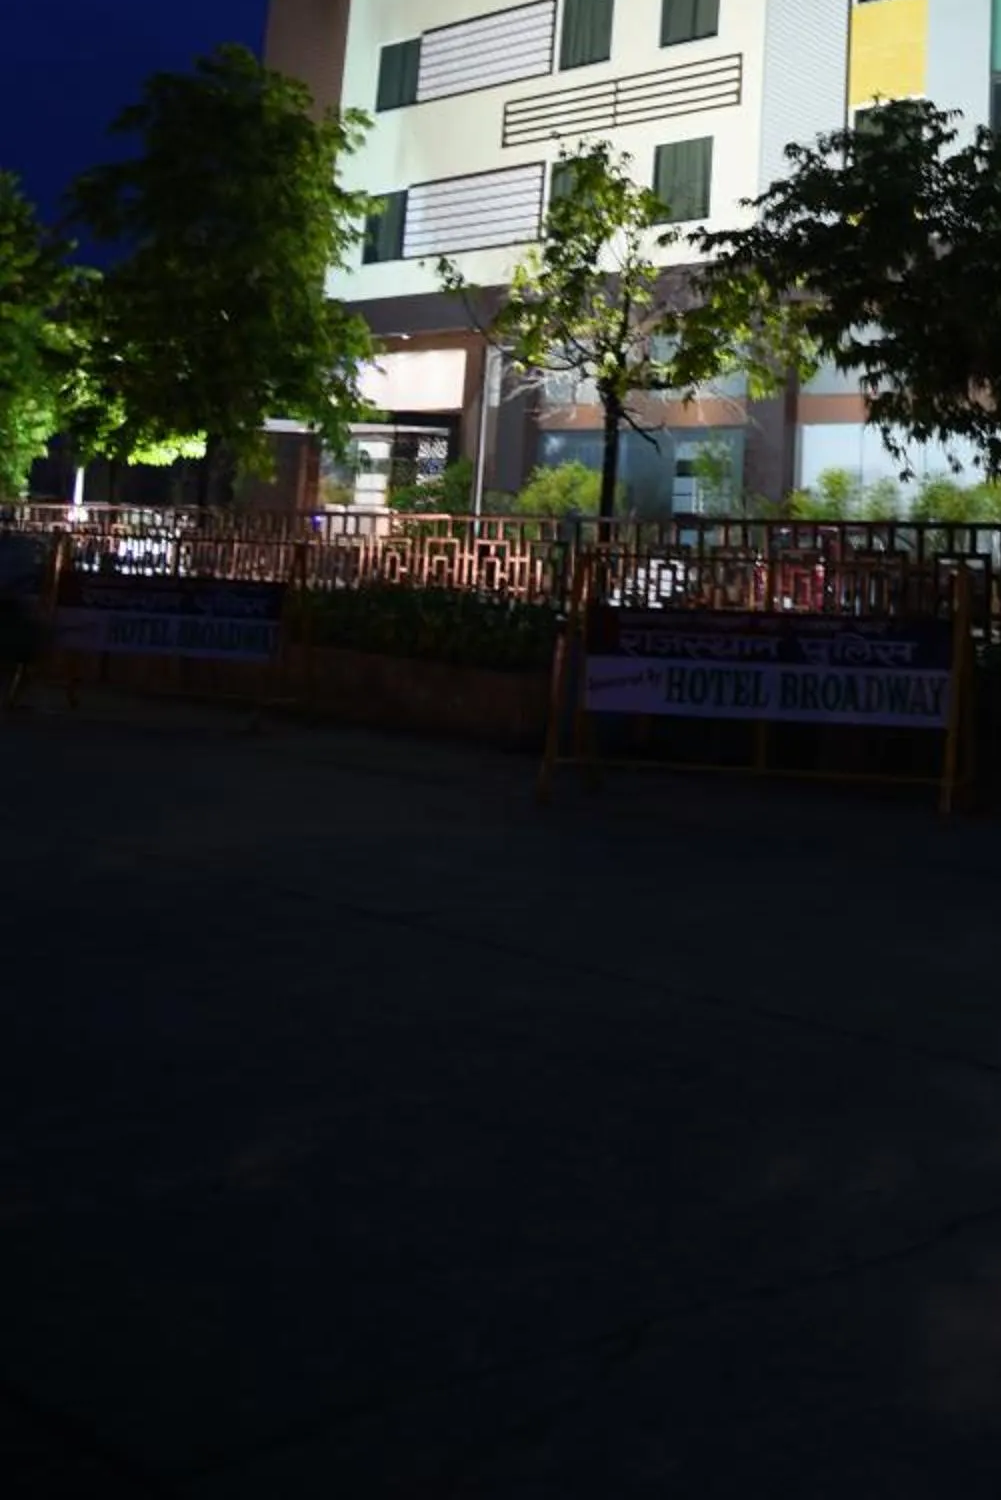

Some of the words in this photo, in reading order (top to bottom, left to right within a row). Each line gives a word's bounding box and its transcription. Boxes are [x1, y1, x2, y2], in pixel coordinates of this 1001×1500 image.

[619, 629, 780, 661] राजस्थान
[797, 631, 918, 665] पुलिस
[664, 666, 771, 708] HOTEL
[779, 671, 949, 715] BROADWAY
